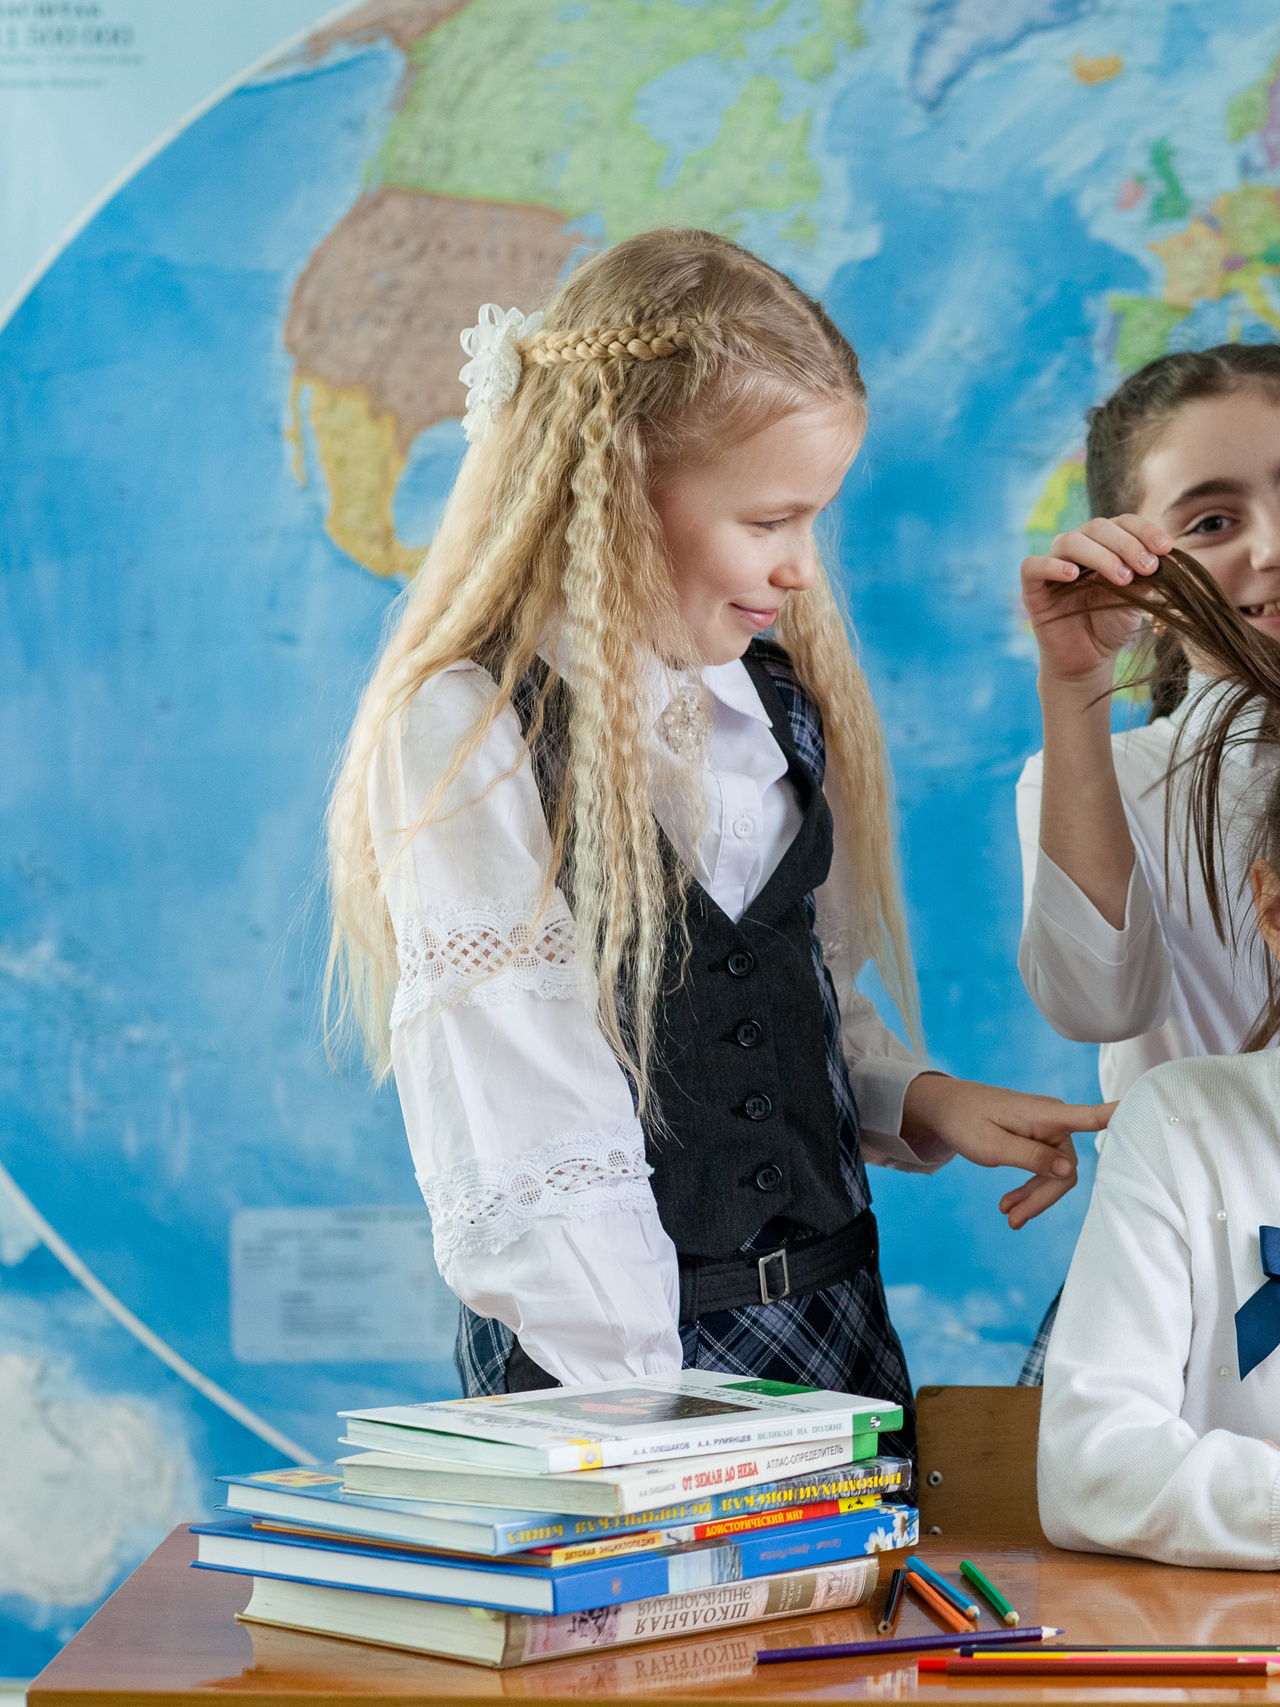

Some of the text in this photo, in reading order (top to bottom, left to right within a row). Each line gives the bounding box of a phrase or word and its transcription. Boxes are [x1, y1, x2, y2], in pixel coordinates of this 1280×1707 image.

[713, 1434, 752, 1447] РУМЯНЦЕВ
[757, 1428, 793, 1441] ВЕЛИКАН
[797, 1427, 808, 1436] НА
[811, 1422, 844, 1434] ПОЛЯНЕ
[682, 1476, 693, 1491] ОТ
[694, 1468, 723, 1488] ЗЕМЛИ
[724, 1467, 735, 1485] ДО
[738, 1461, 759, 1480] НЕБА
[766, 1444, 844, 1470] АТЛАС-ОПРЕДЕЛИТЕЛЬ
[575, 1501, 711, 1534] ИСТОРИЧЕСКАЯ
[507, 1524, 564, 1545] КНИГА
[564, 1509, 804, 1561] ДЕТСКАЯ ЭНЦИКЛОПЕДИЯ ДОИСТОРИЧЕСКИЙ МИР
[637, 1586, 753, 1617] ЭНЦИКЛОПЕДИЯ
[634, 1602, 750, 1635] ШКОЛЬНАЯ
